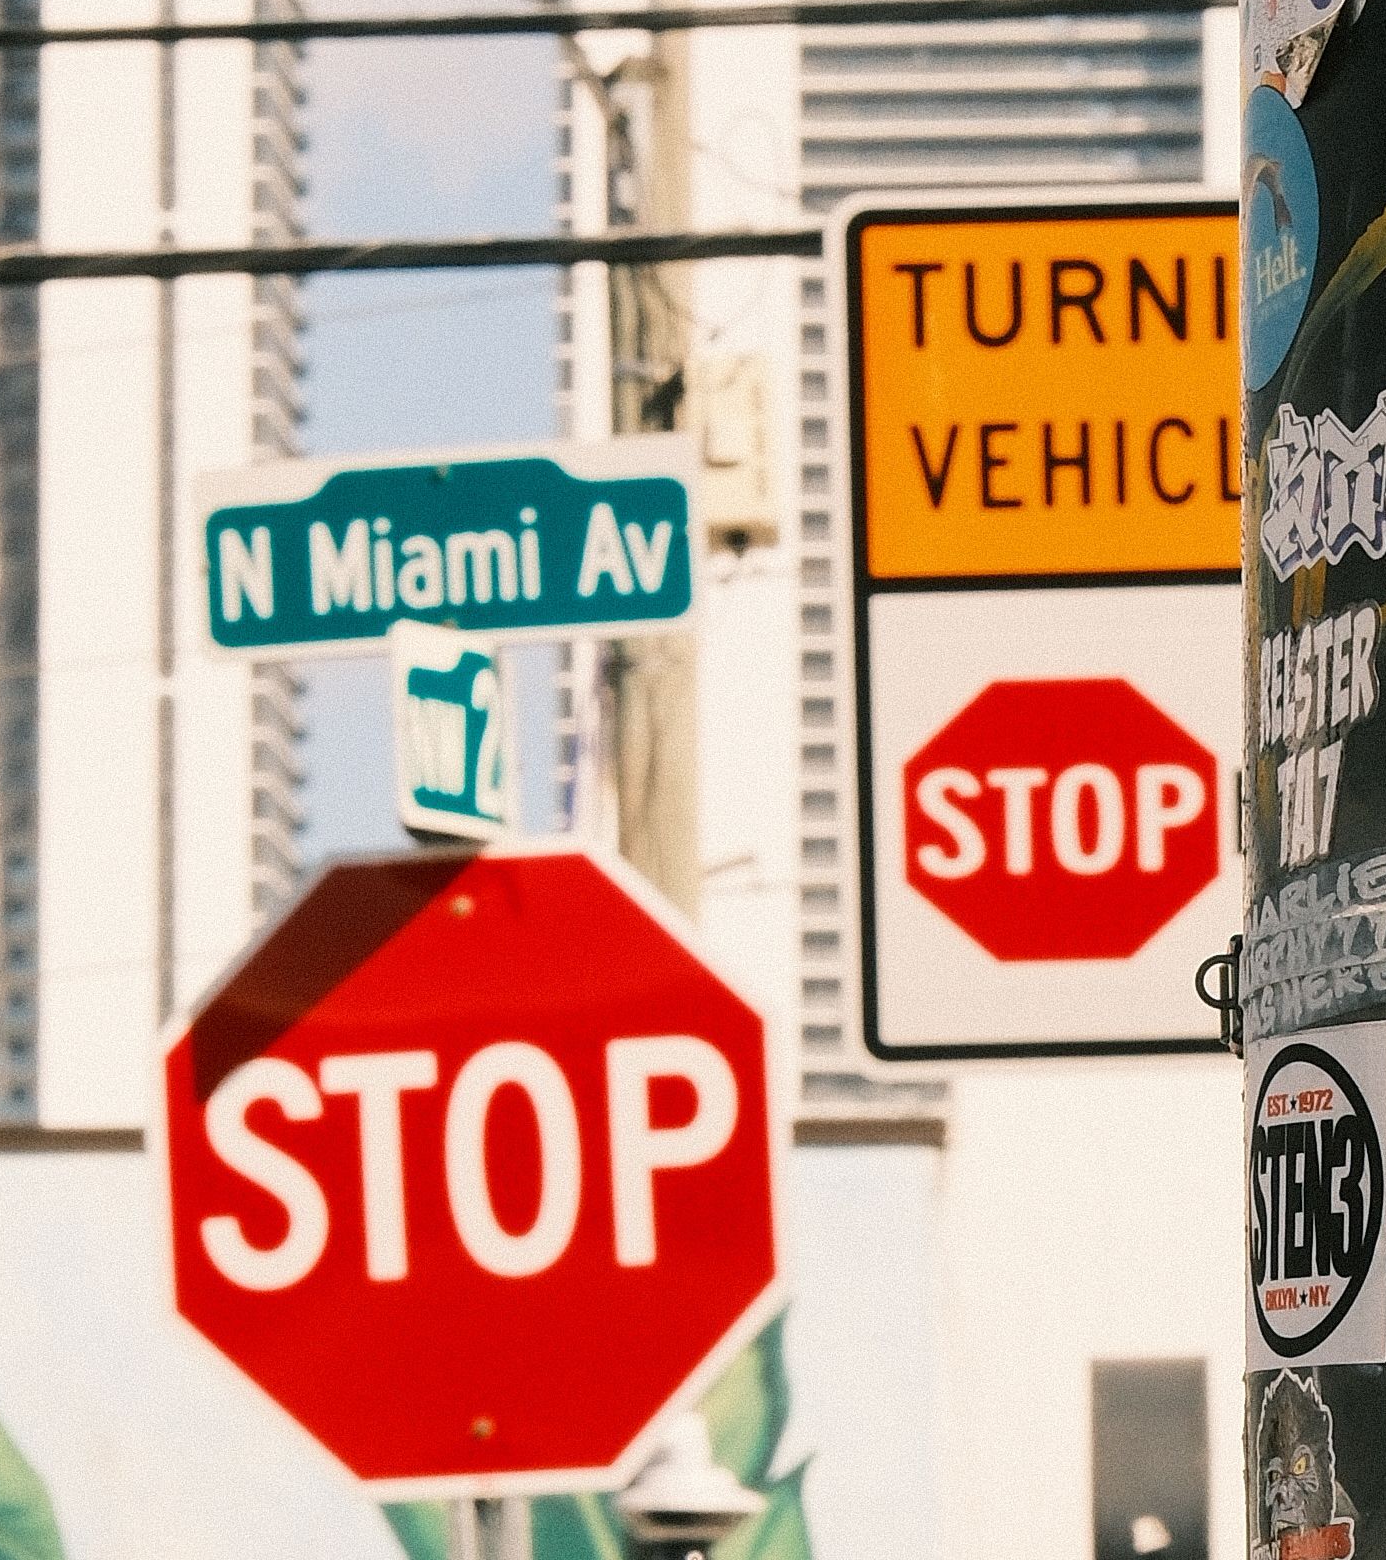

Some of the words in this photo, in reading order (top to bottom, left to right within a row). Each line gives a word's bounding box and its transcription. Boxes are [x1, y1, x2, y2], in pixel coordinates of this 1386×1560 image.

[218, 525, 275, 624] N
[310, 506, 542, 617] Miami
[577, 501, 673, 598] Av
[913, 762, 1206, 881] STOP
[199, 1033, 739, 1293] STOP
